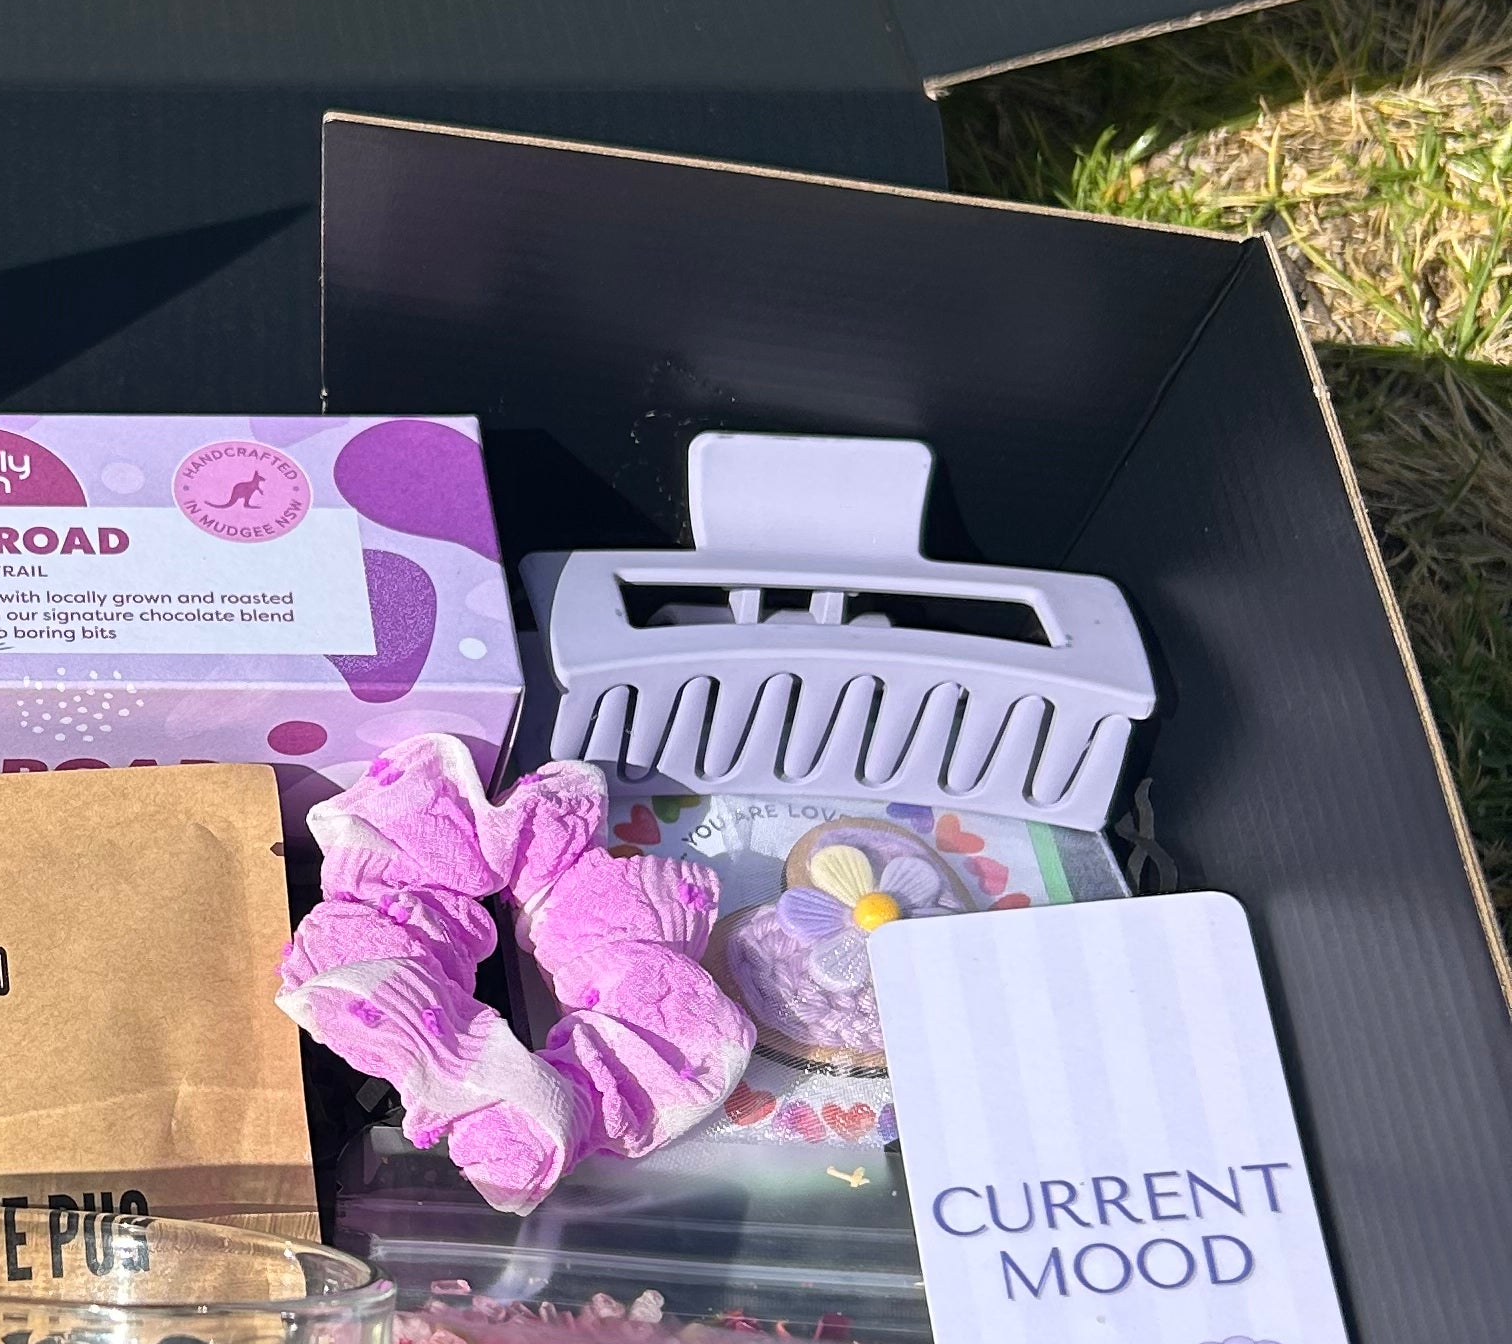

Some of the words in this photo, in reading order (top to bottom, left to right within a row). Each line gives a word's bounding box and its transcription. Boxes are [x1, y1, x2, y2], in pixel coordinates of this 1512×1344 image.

[182, 446, 298, 480] HANDCRAFTED
[183, 499, 202, 515] IN
[199, 514, 276, 538] MUDGEE
[275, 499, 303, 529] NSW
[0, 591, 40, 604] with
[46, 590, 108, 607] locally
[112, 592, 172, 607] grown
[178, 591, 214, 605] and
[220, 591, 294, 605] roasted
[7, 610, 37, 622] our
[42, 608, 134, 624] signature
[139, 608, 235, 623] chocolate
[240, 608, 295, 623] blend
[13, 625, 76, 642] boring
[82, 626, 117, 640] bits
[681, 815, 726, 846] YOU
[788, 804, 846, 824] LOV
[930, 1161, 1294, 1238] CURRENT
[48, 1189, 151, 1278] PUG
[999, 1233, 1256, 1301] MOOD
